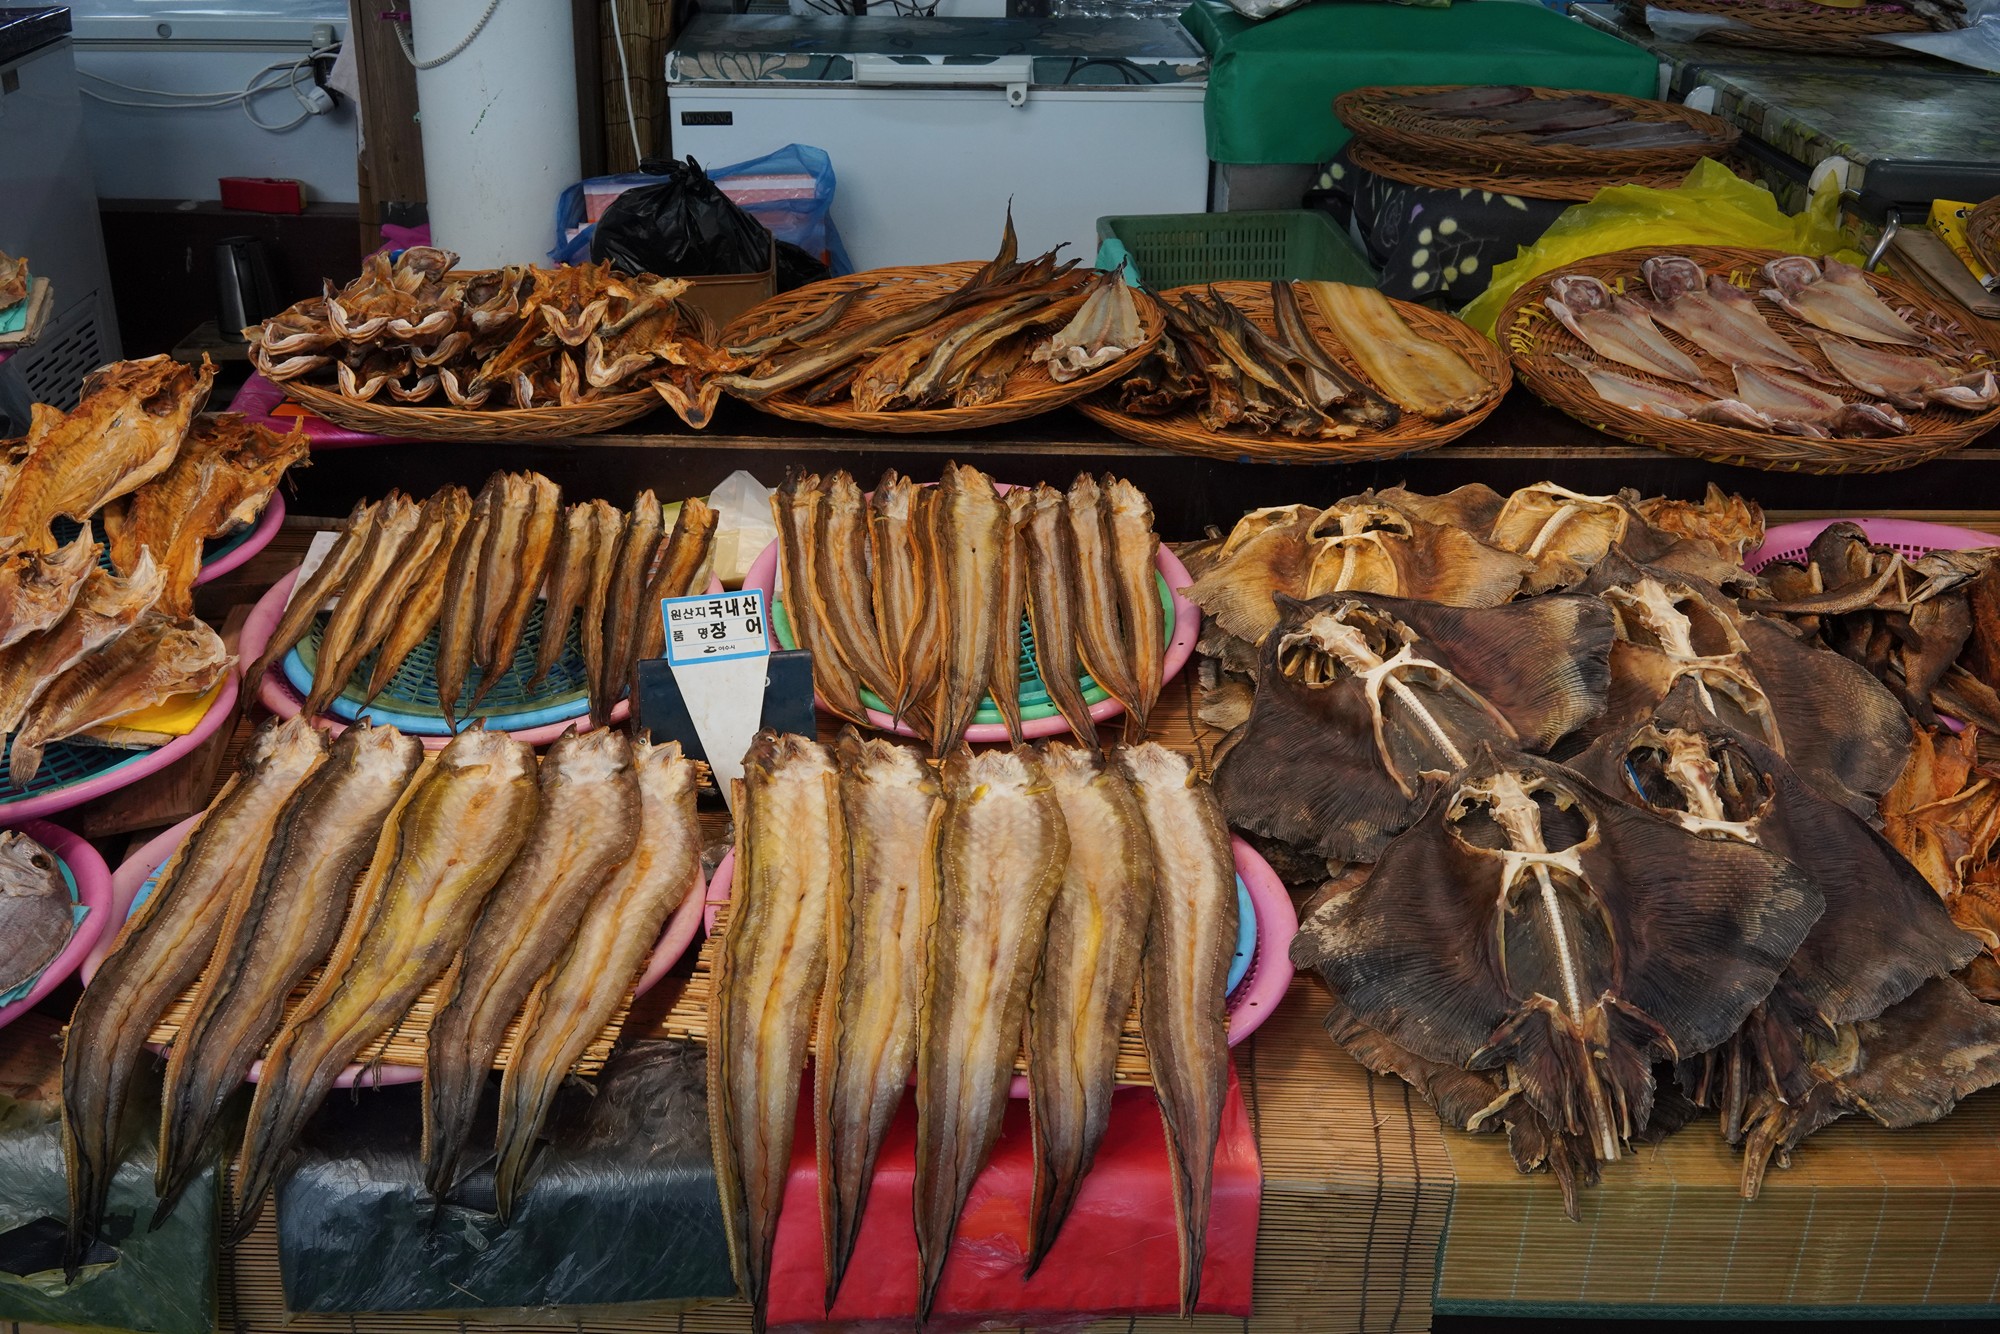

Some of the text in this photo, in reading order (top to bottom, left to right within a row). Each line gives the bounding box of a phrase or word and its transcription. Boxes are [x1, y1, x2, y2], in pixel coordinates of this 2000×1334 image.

[683, 112, 731, 124] WOOSUNG
[670, 595, 758, 621] 원산지 국내산
